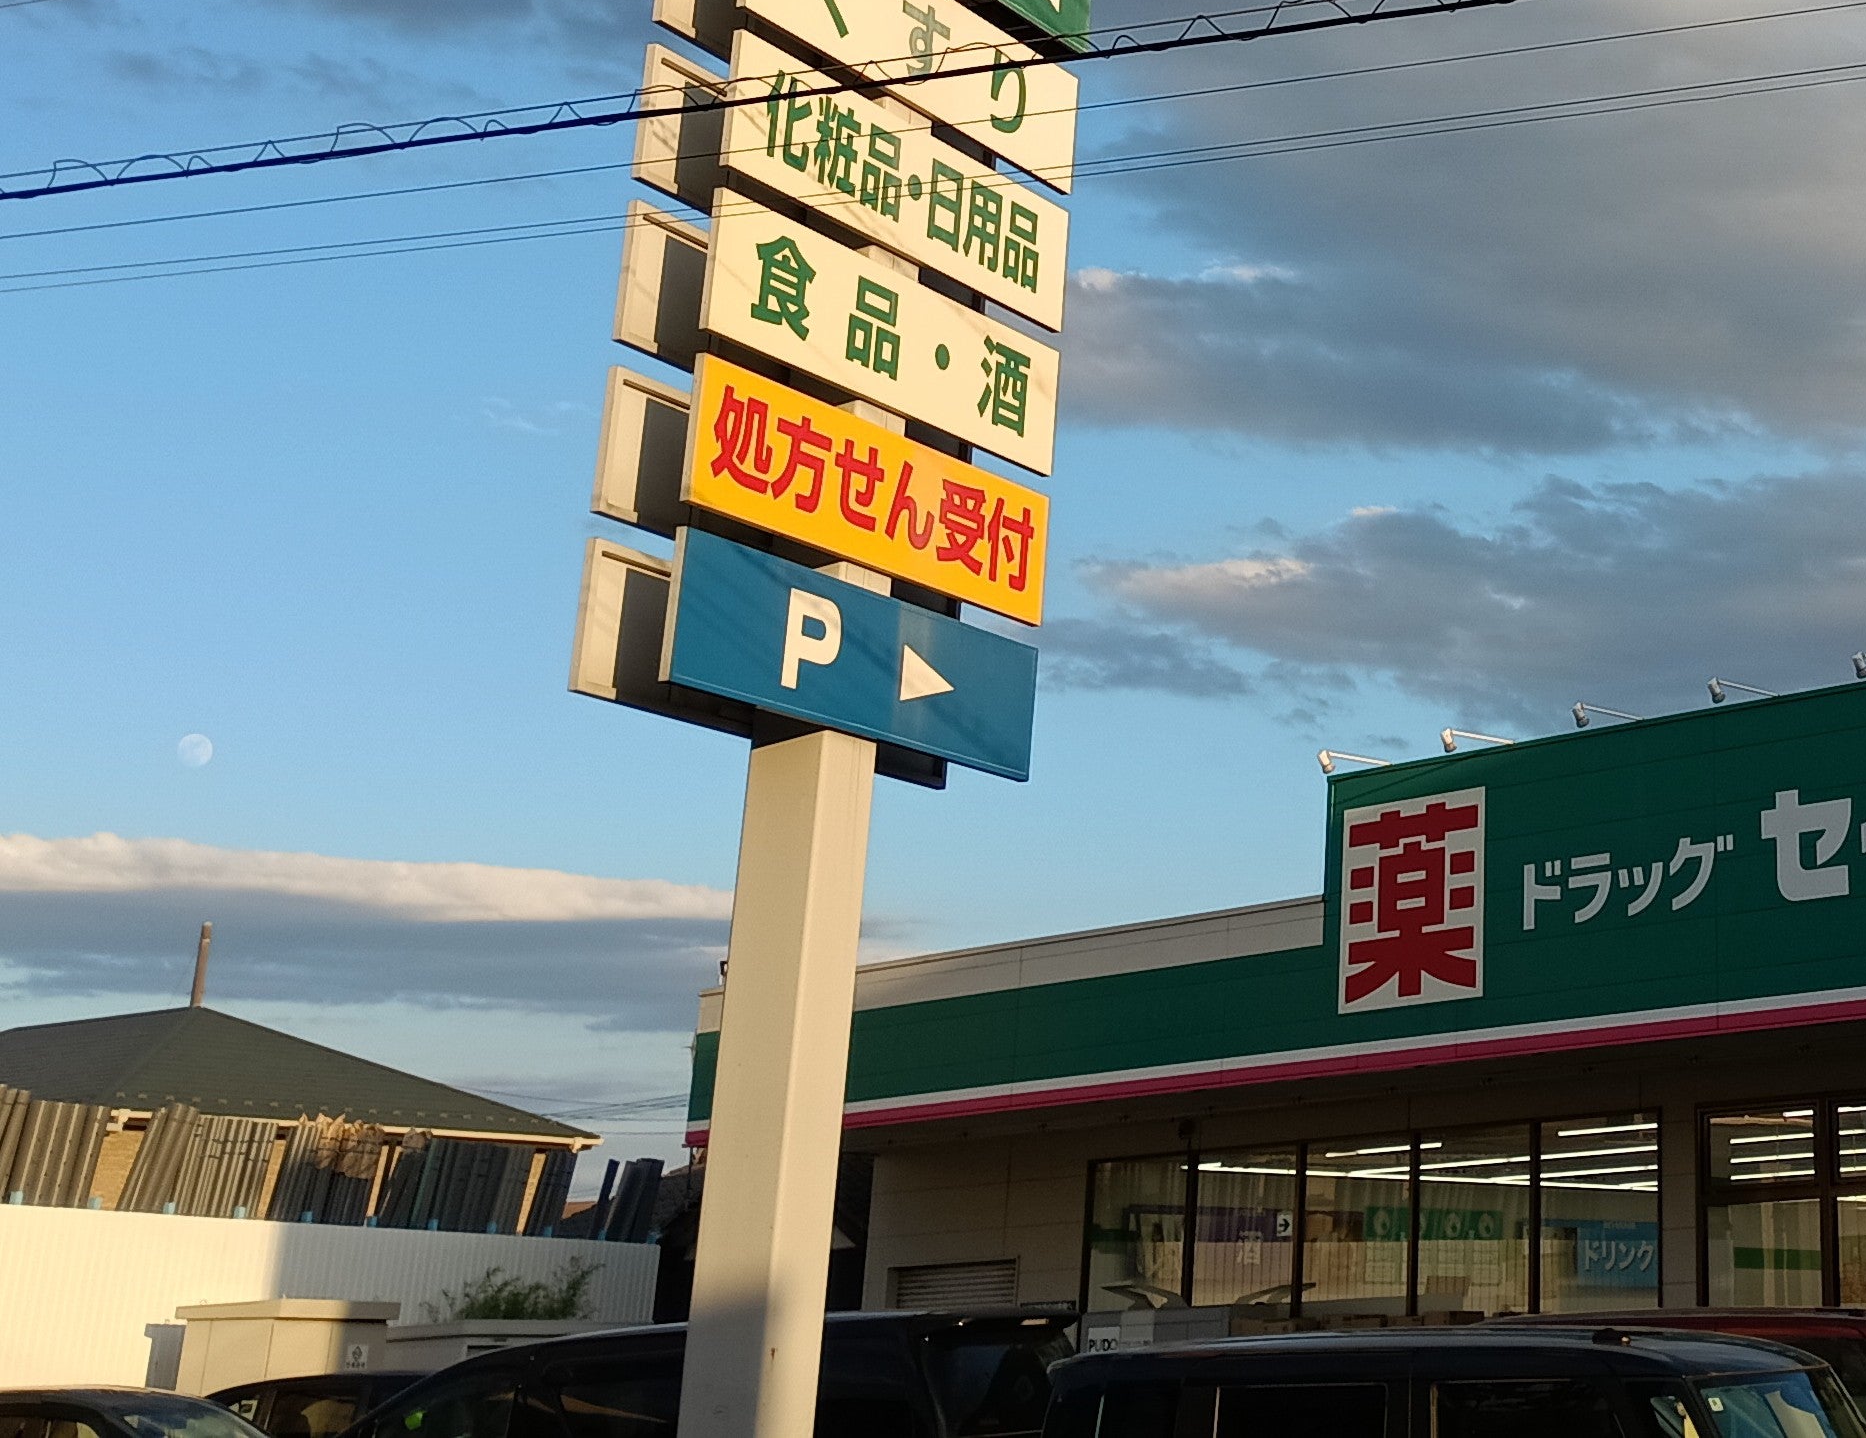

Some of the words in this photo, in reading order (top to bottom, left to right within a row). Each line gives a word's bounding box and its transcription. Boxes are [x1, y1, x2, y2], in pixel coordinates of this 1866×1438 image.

[765, 69, 1040, 294] 化粧品・日用品
[710, 385, 1035, 592] 処方せん受付
[780, 587, 842, 690] P
[1344, 801, 1479, 1005] 薬
[1522, 833, 1734, 931] ドラッグ
[1584, 1239, 1655, 1272] ドリンク
